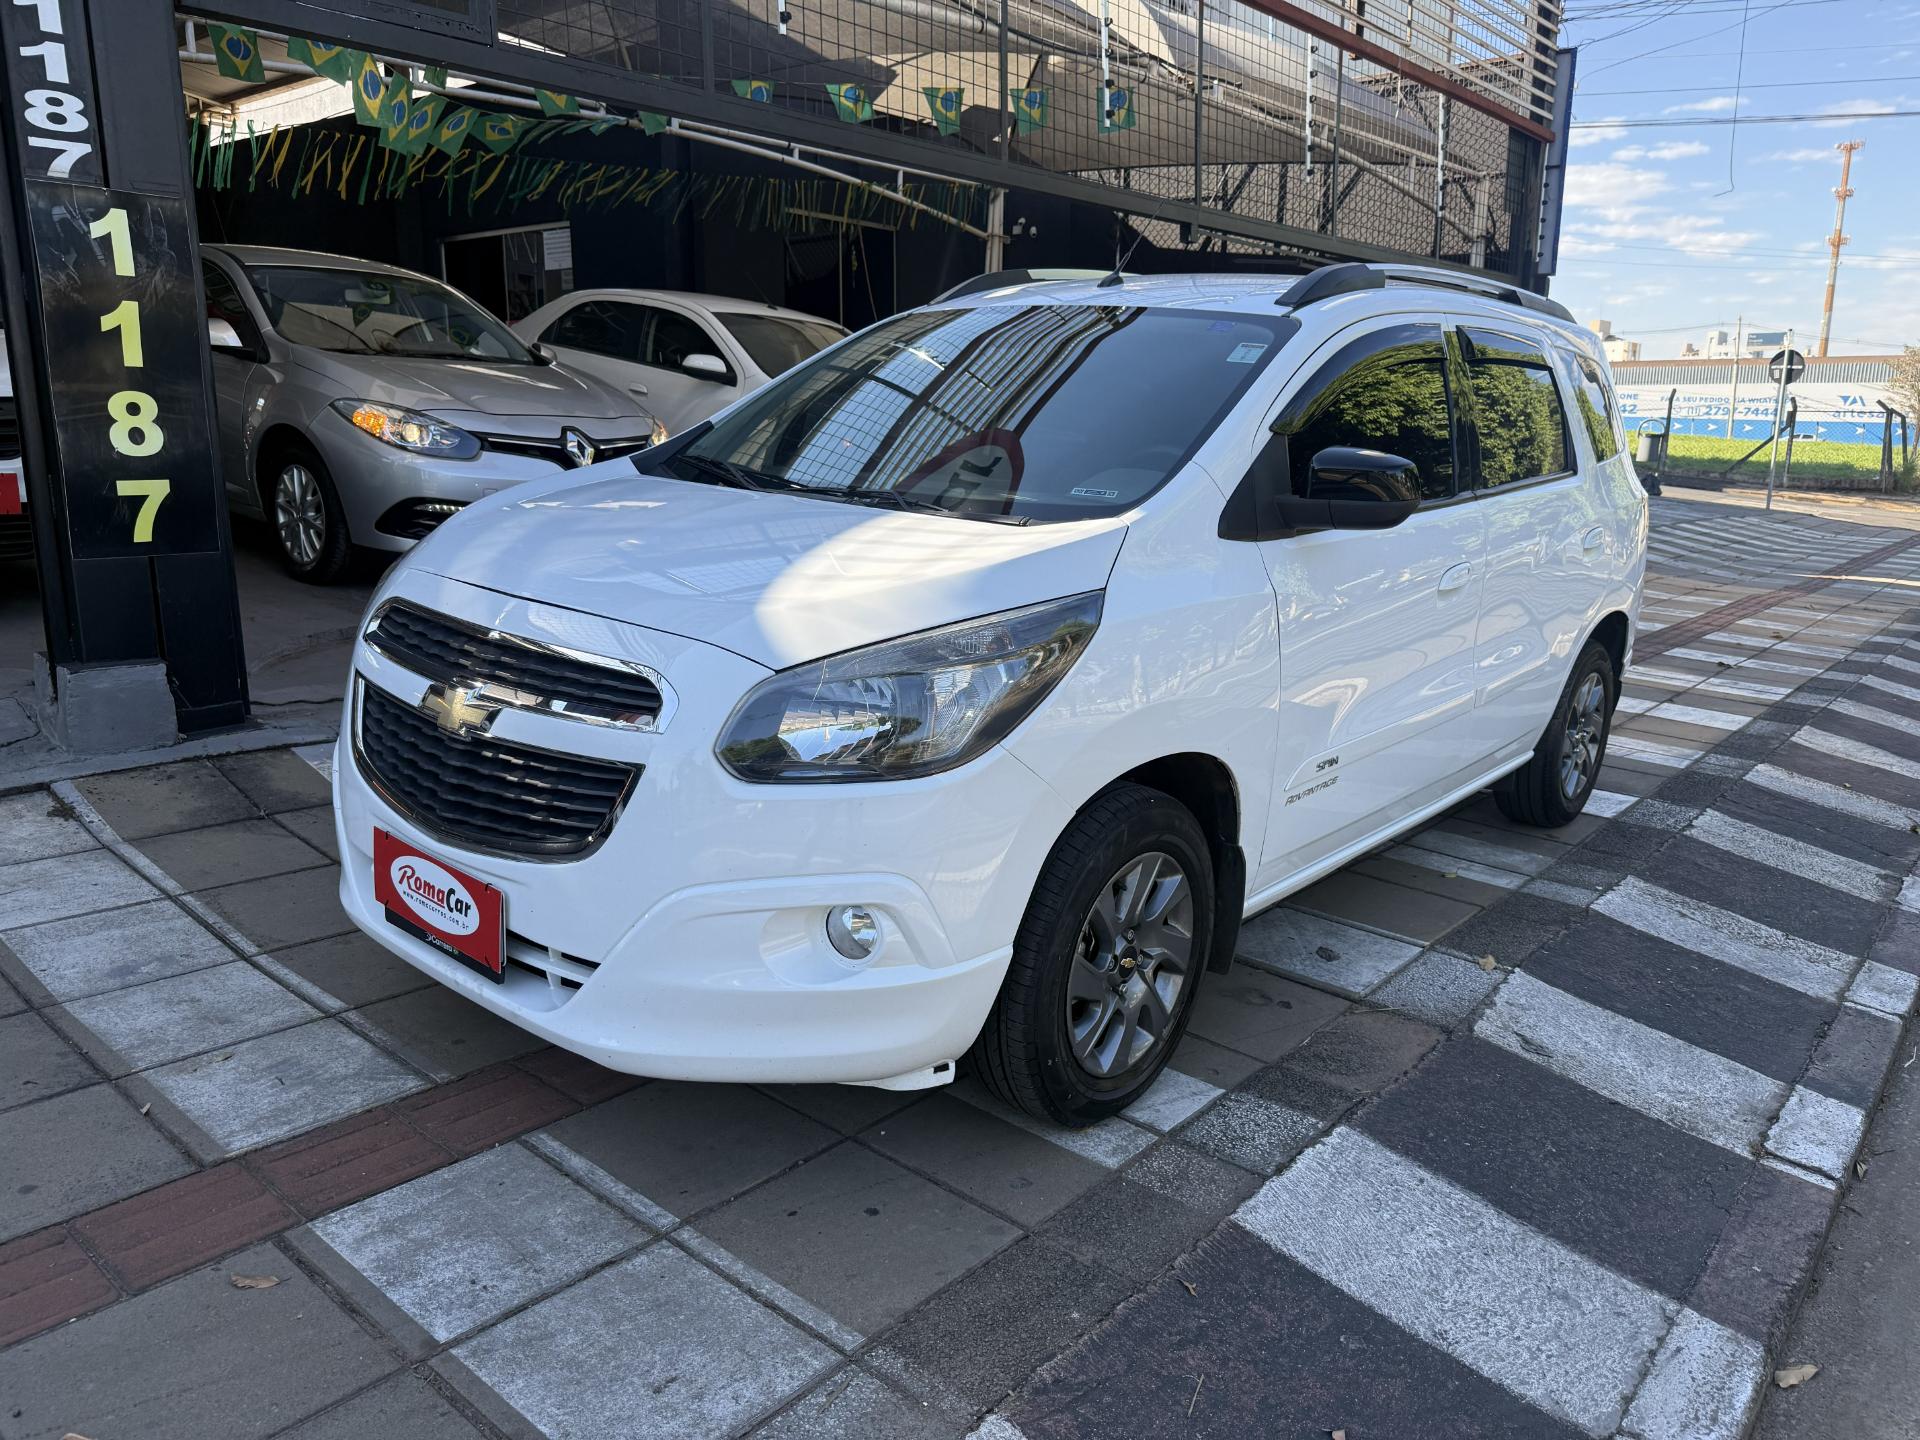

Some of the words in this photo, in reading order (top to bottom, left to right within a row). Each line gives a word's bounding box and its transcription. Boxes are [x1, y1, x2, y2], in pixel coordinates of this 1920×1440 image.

[89, 207, 171, 544] 1187
[1660, 395, 1682, 403] FAA
[1699, 396, 1730, 404] PEDIDO
[1316, 755, 1339, 773] SPIN
[1285, 776, 1339, 807] ADVANTAGE
